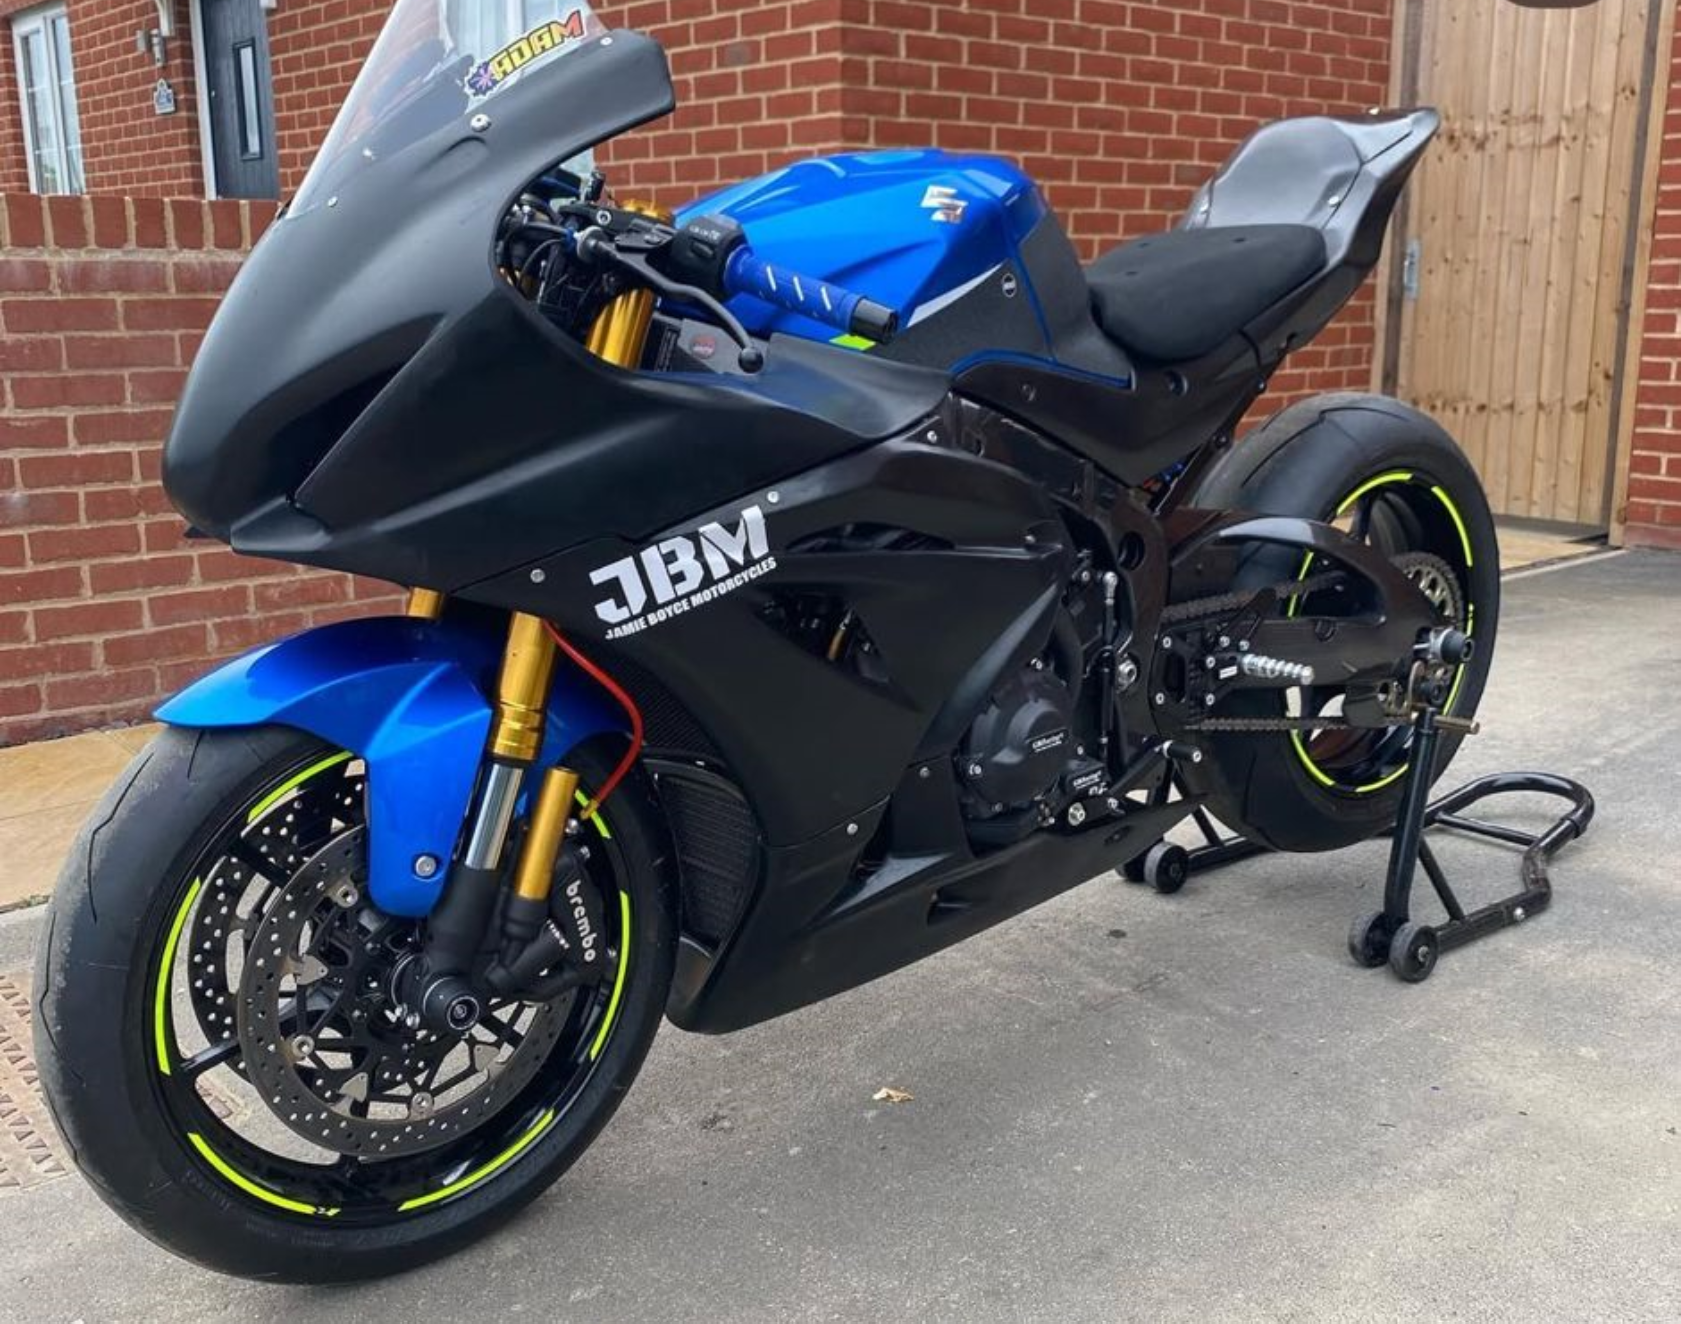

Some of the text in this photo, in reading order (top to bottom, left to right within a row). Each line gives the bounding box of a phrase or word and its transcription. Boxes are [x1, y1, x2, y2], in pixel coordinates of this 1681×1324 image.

[489, 9, 584, 82] ADAM
[589, 504, 769, 624] JBM
[605, 557, 777, 640] JAMIE BOYCE MOTORCYCLES
[566, 879, 597, 962] brembo
